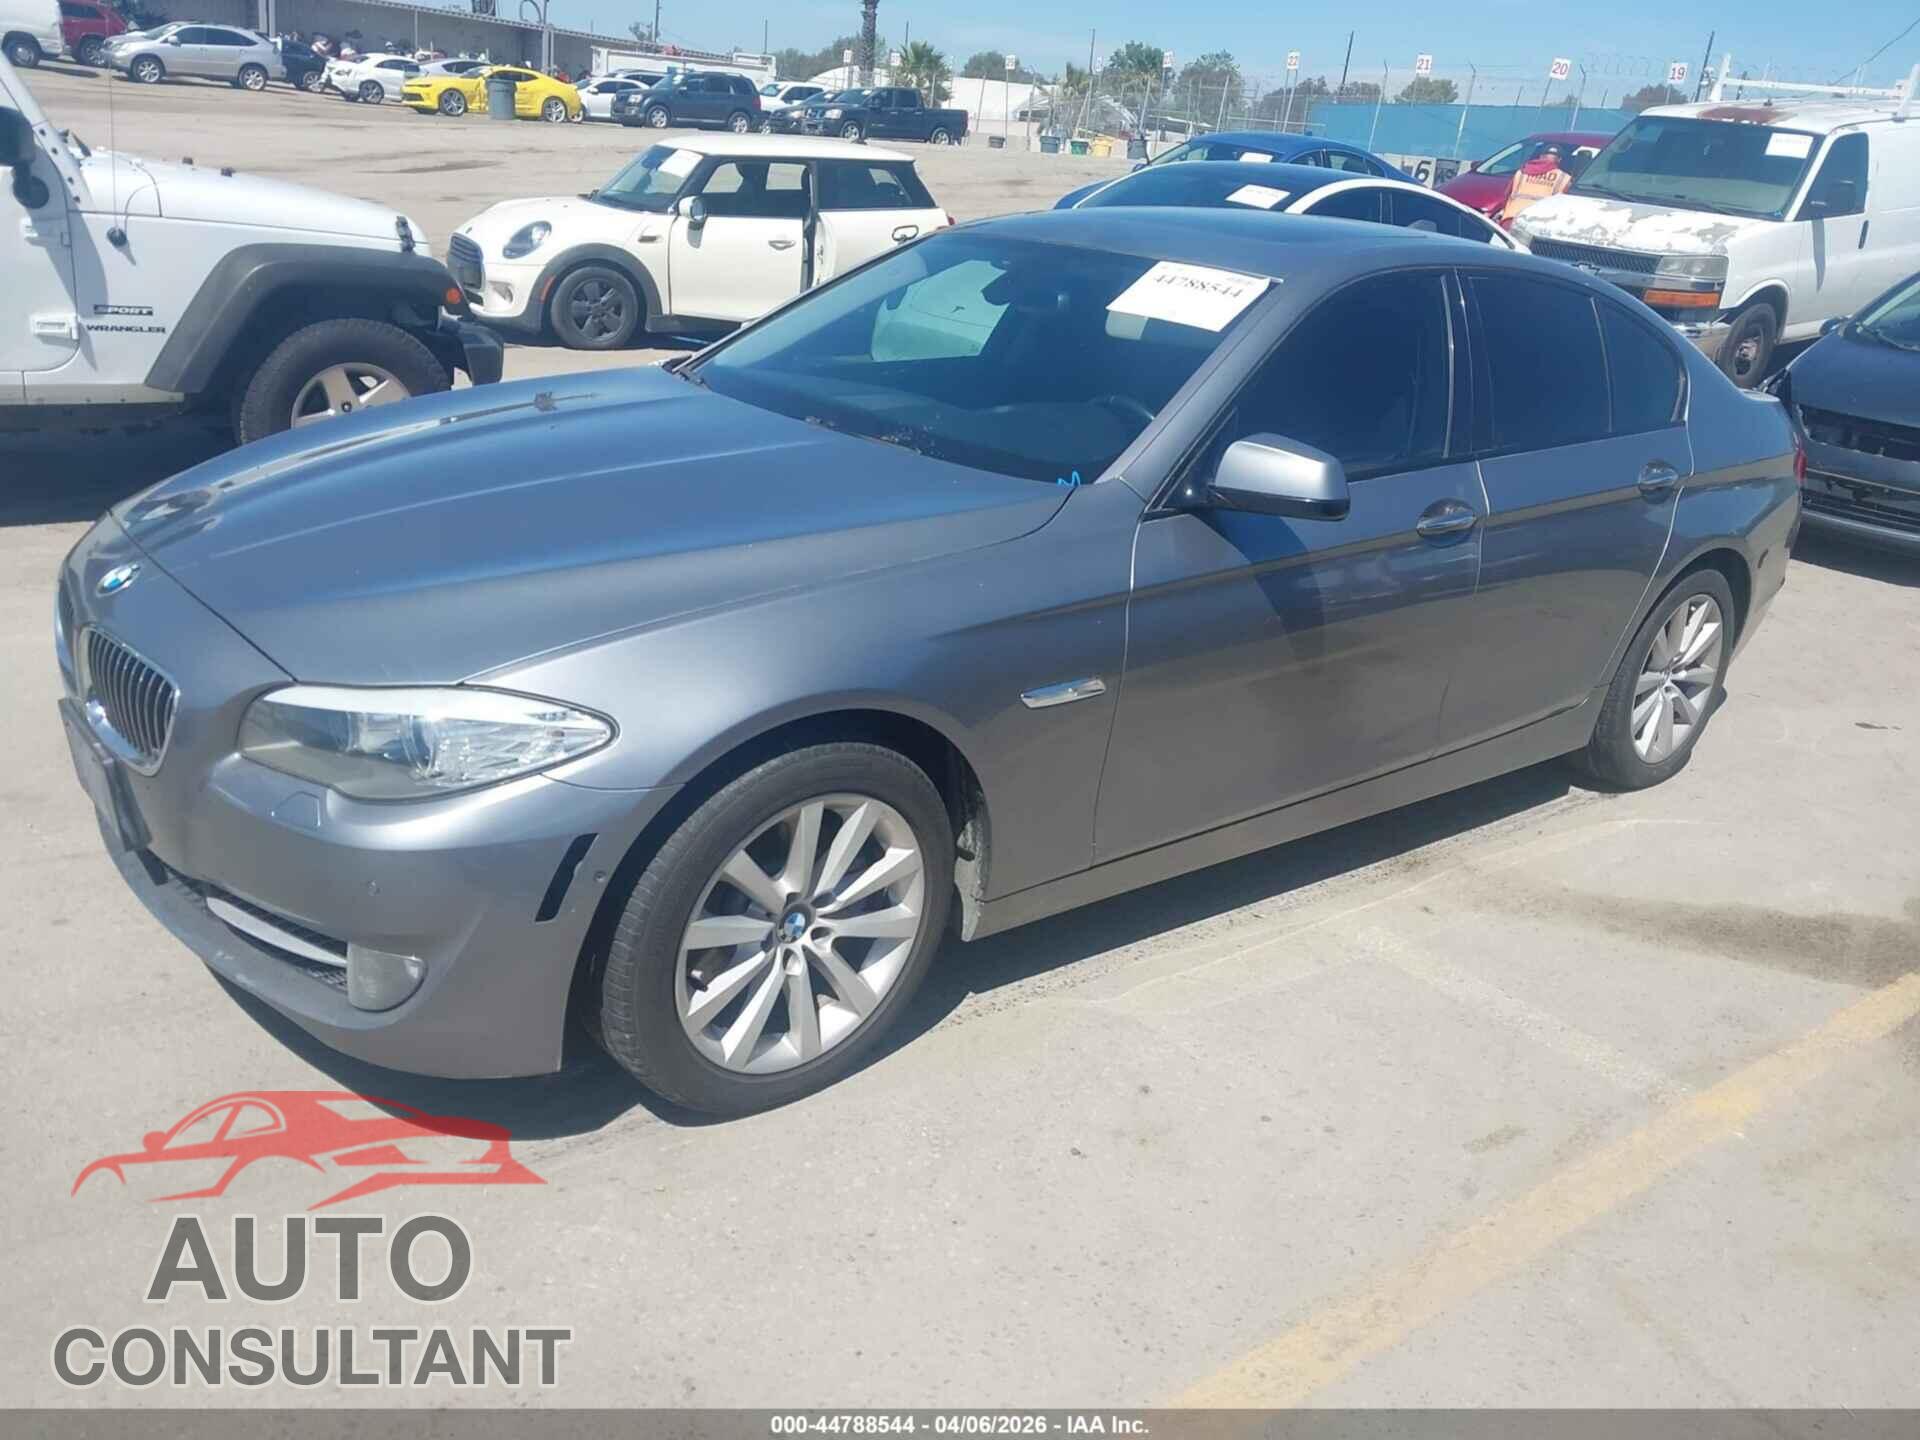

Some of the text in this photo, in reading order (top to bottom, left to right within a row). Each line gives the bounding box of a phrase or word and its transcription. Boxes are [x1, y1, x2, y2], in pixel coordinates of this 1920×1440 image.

[1417, 58, 1431, 70] 21
[1552, 61, 1569, 76] 20
[1670, 66, 1686, 80] 19
[1154, 274, 1243, 298] 44788544
[86, 324, 166, 334] WRANGLER
